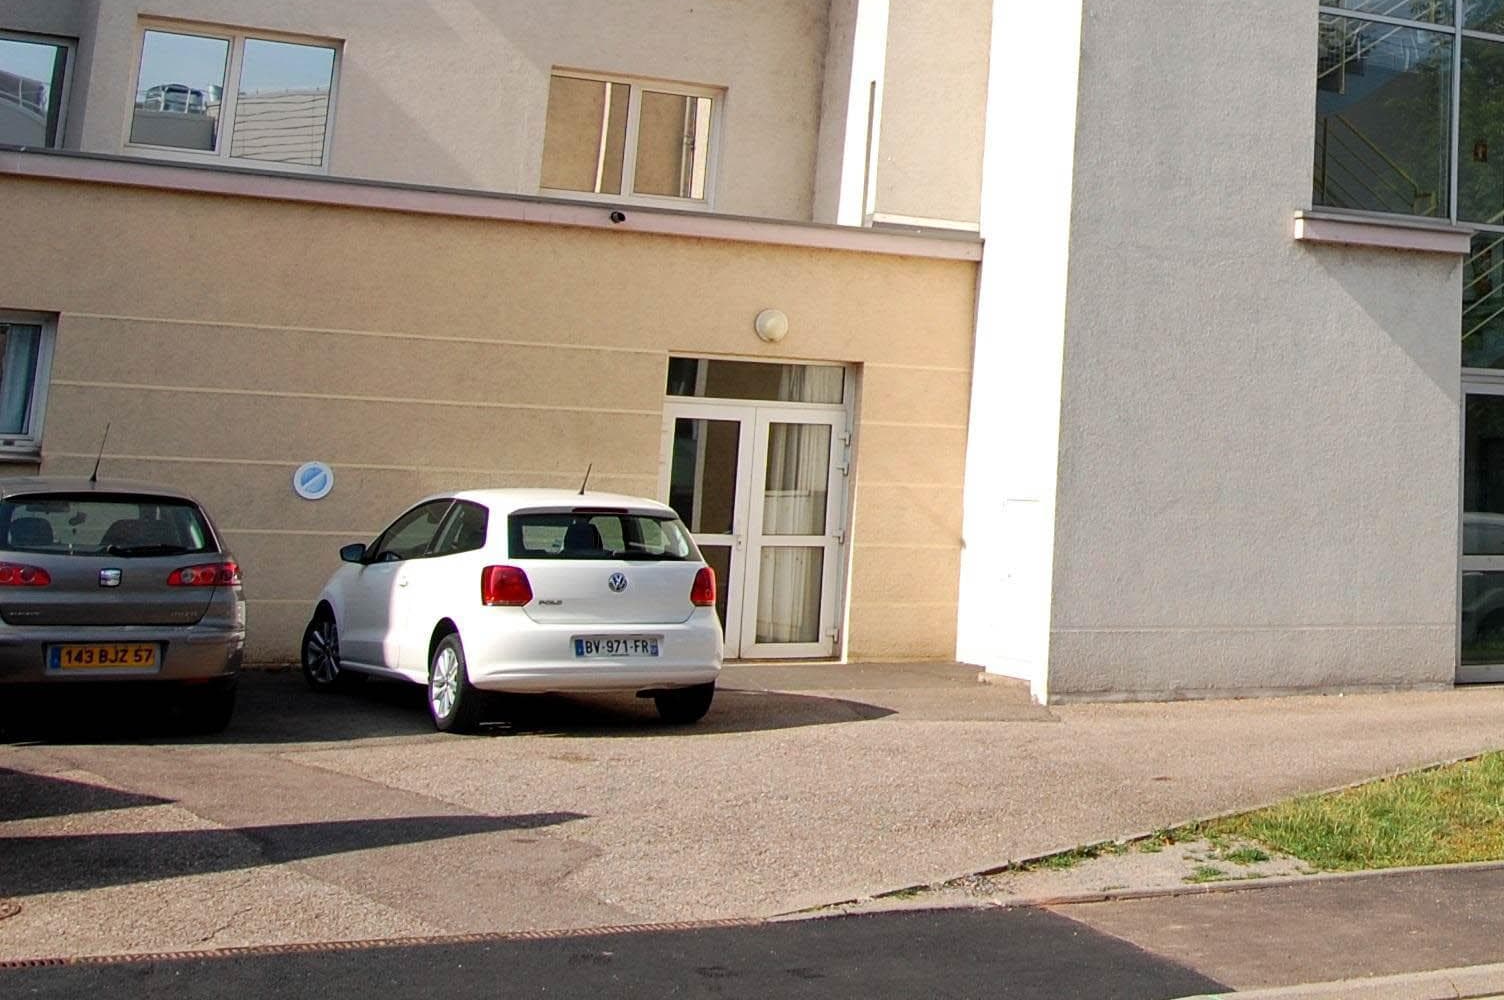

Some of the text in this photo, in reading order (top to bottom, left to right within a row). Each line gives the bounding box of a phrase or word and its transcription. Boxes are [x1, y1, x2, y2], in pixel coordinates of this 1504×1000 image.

[65, 647, 153, 664] 143 BJZ 57
